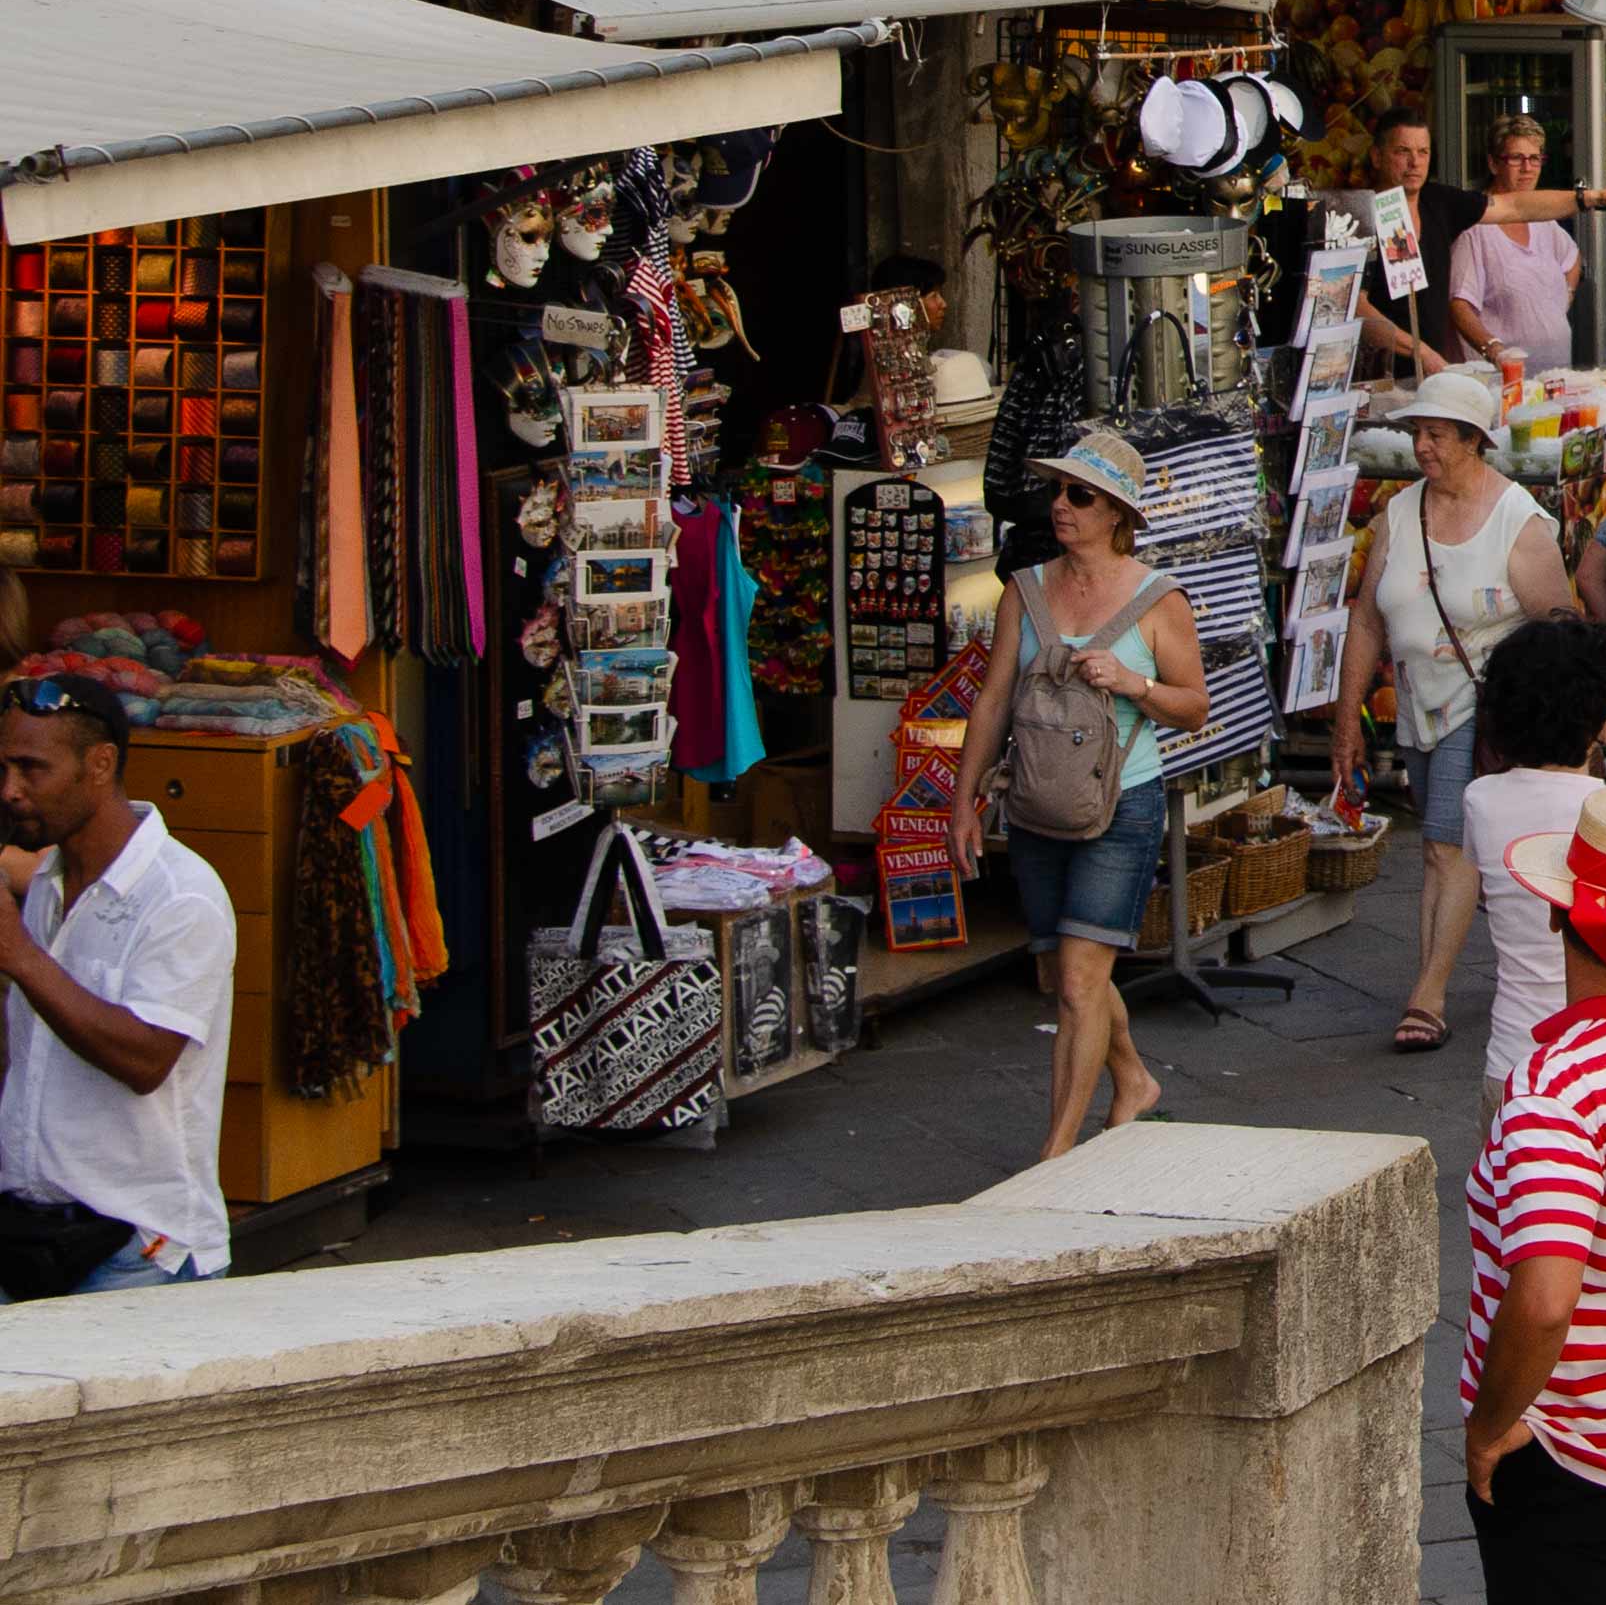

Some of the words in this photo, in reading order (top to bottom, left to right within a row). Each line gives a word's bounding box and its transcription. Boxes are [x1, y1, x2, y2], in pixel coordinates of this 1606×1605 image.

[1125, 237, 1219, 256] SUNGLASSES
[889, 816, 950, 835] VENECIA
[886, 849, 950, 870] VENEDIG
